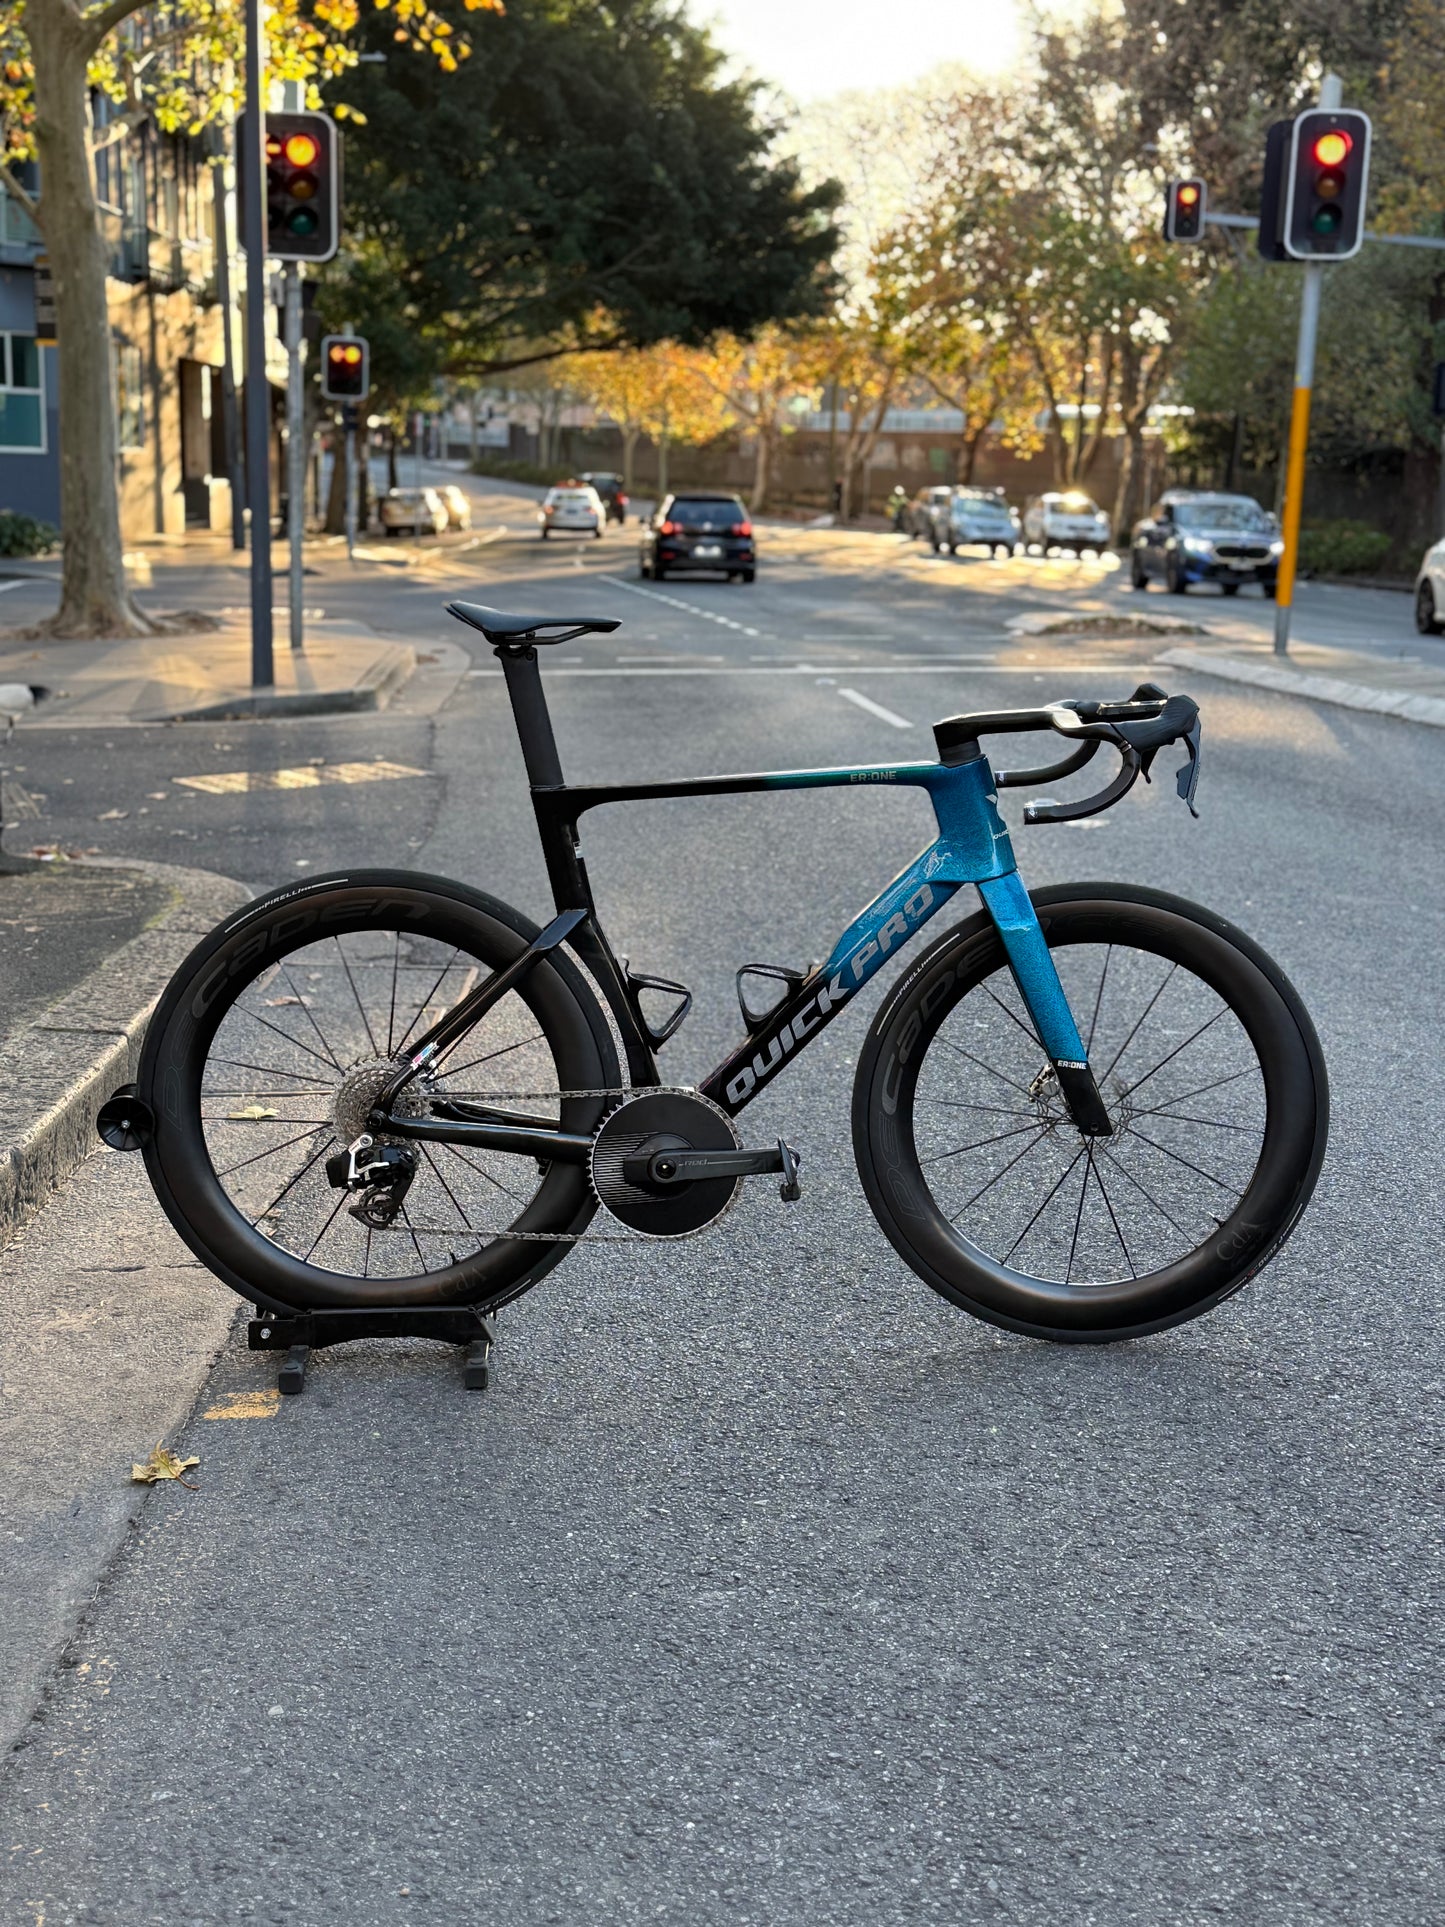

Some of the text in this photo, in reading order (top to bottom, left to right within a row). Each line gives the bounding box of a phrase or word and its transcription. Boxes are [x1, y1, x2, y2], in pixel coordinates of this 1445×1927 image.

[850, 770, 897, 782] ER:ONE
[264, 888, 302, 909] PIRELLI
[898, 963, 925, 996] PIRELLI
[726, 883, 935, 1105] QUICK PRO
[1057, 1059, 1087, 1070] ER:ONE
[1217, 1221, 1269, 1261] CdA
